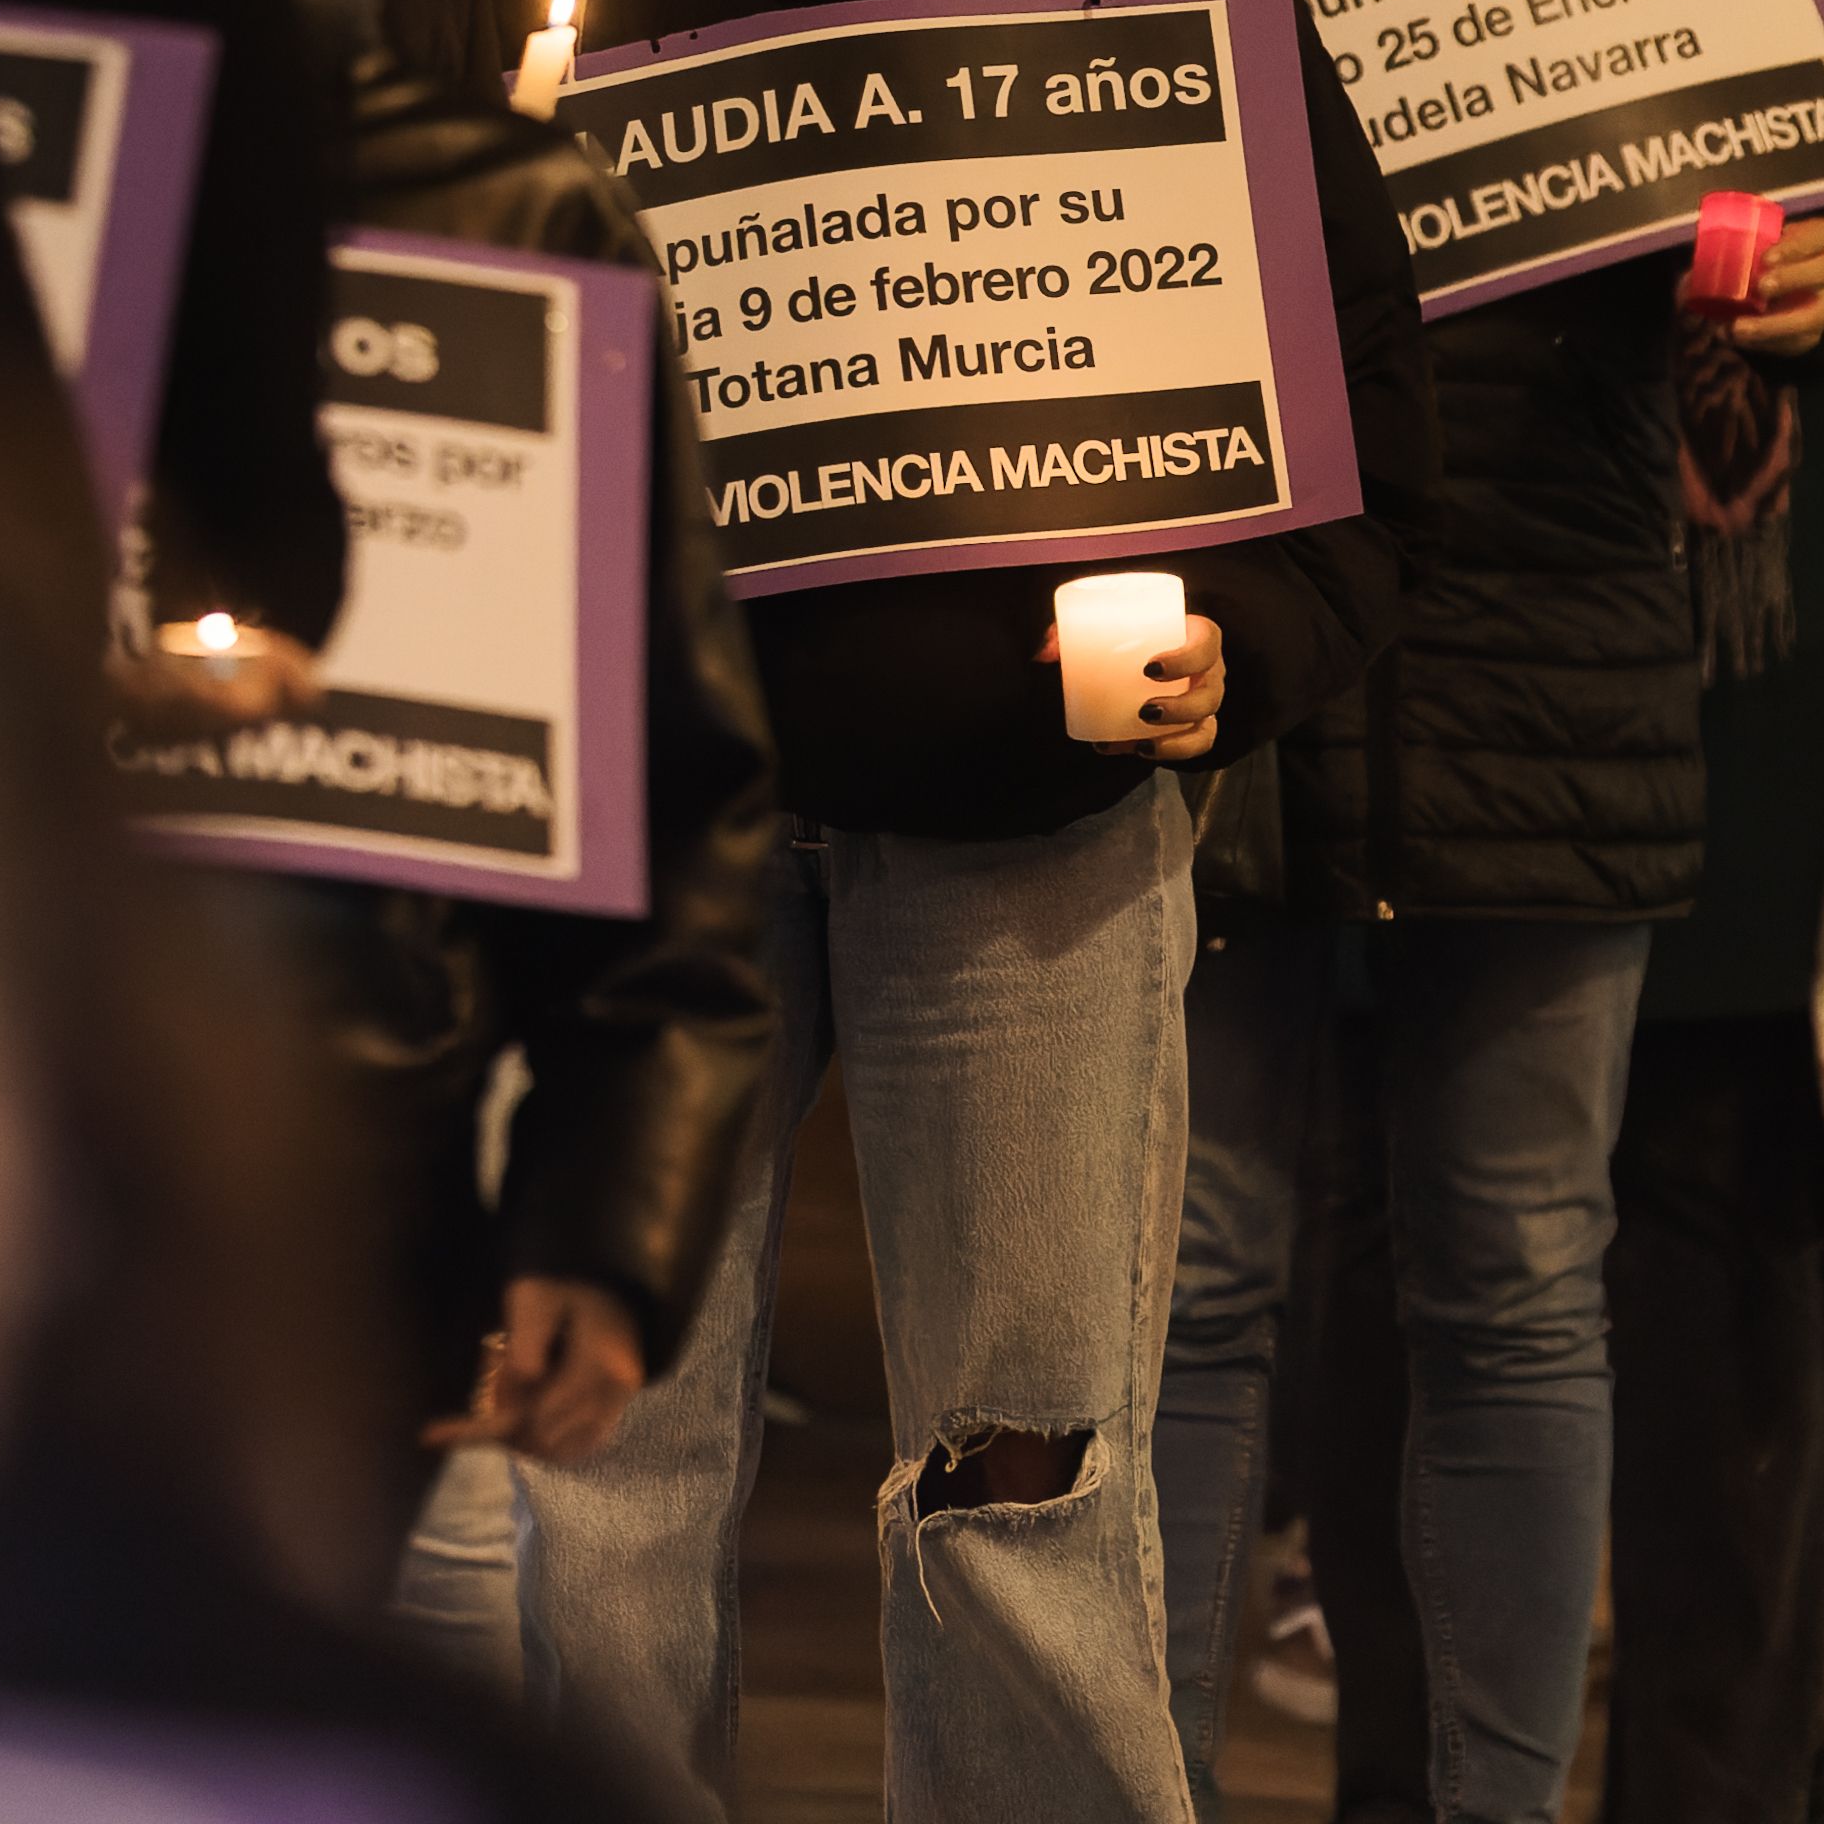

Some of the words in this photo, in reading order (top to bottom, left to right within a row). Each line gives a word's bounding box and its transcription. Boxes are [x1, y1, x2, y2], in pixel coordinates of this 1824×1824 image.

[1377, 17, 1440, 73] 25
[1453, 3, 1514, 47] de
[1506, 25, 1704, 110] Navarra
[854, 72, 924, 129] A.
[946, 63, 1020, 120] 17
[1045, 57, 1212, 116] años
[662, 192, 927, 284] puñalada
[946, 193, 1042, 250] por
[1060, 186, 1126, 223] su
[739, 286, 773, 331] 9
[788, 275, 857, 322] de
[870, 261, 1070, 313] febrero
[1087, 242, 1223, 296] 2022
[684, 352, 880, 414] Totana
[900, 326, 1095, 384] Murcia
[706, 452, 983, 528] VIOLENCIA
[991, 426, 1263, 493] MACHISTA
